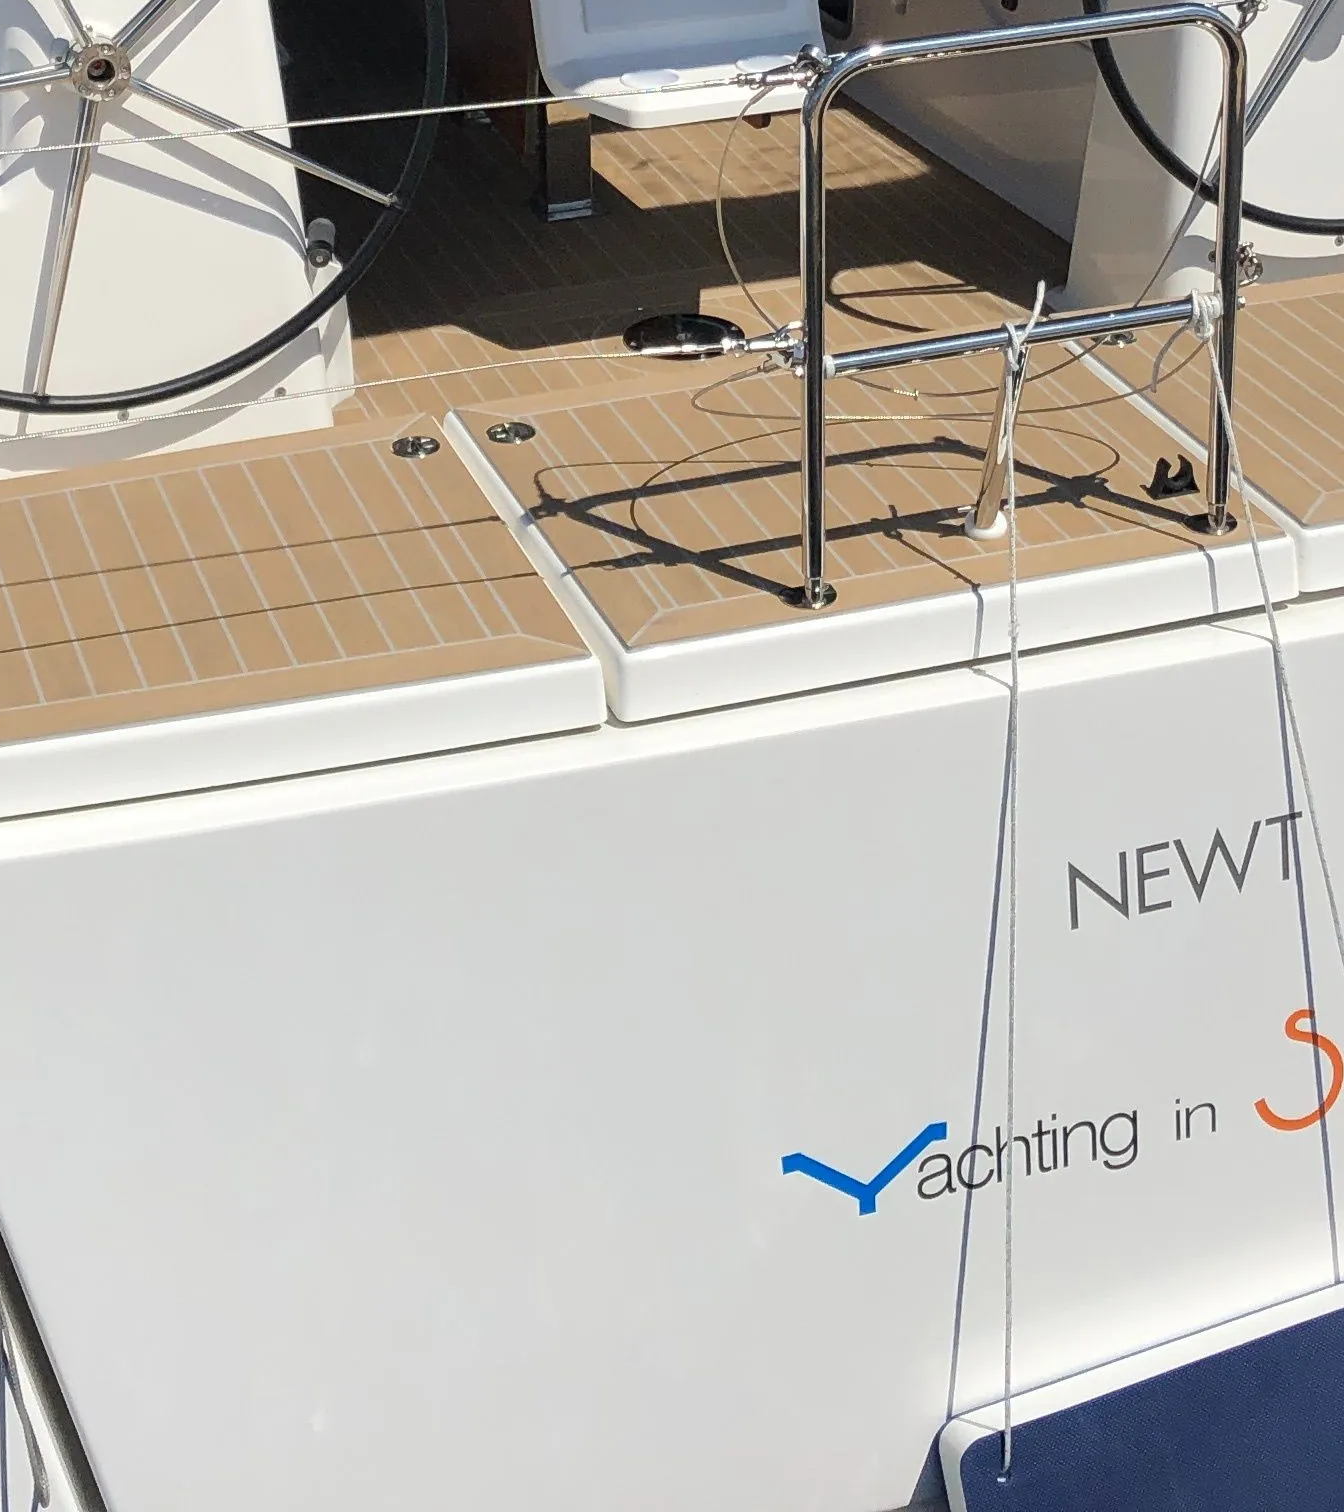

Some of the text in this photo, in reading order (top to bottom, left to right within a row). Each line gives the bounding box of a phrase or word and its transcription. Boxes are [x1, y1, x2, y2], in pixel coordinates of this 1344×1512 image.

[1067, 811, 1303, 930] NEWT
[781, 1108, 1139, 1216] Yachting
[1174, 1098, 1218, 1141] in
